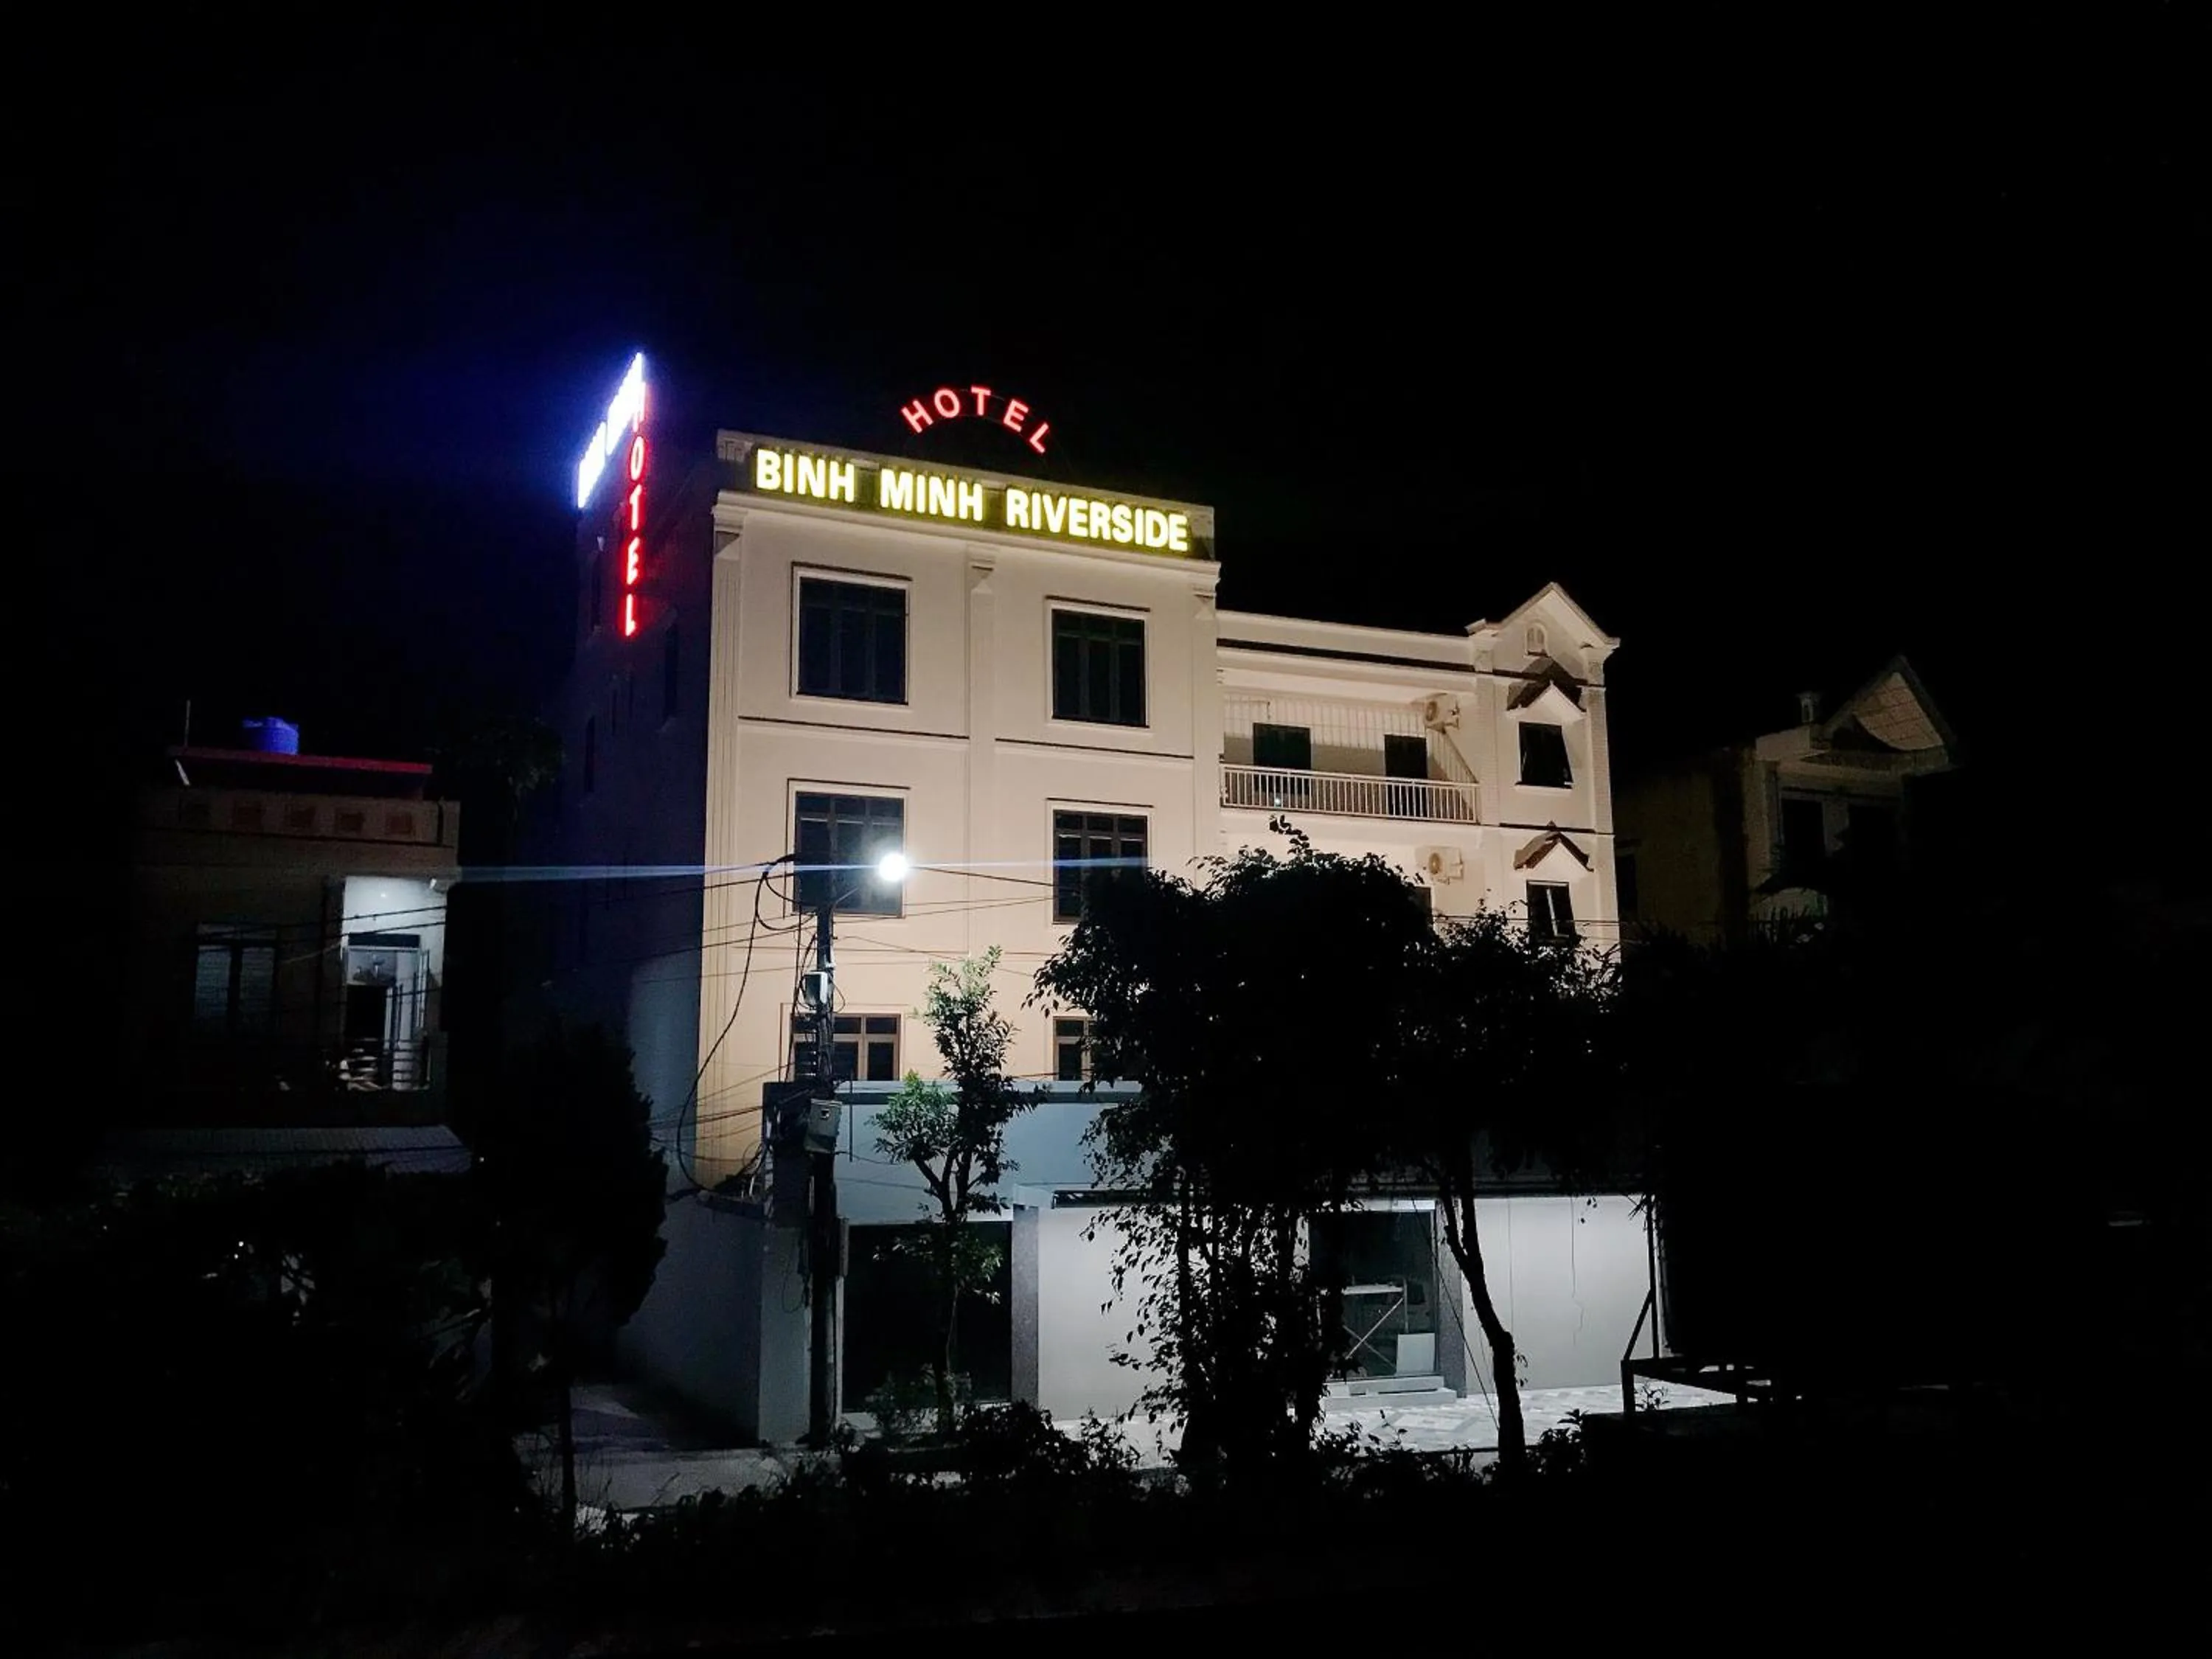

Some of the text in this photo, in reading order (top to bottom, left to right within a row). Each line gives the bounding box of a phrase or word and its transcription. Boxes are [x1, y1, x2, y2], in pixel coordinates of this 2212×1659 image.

[901, 386, 1052, 453] HOTEL
[756, 448, 1189, 552] BINH MINH RIVERSIDE
